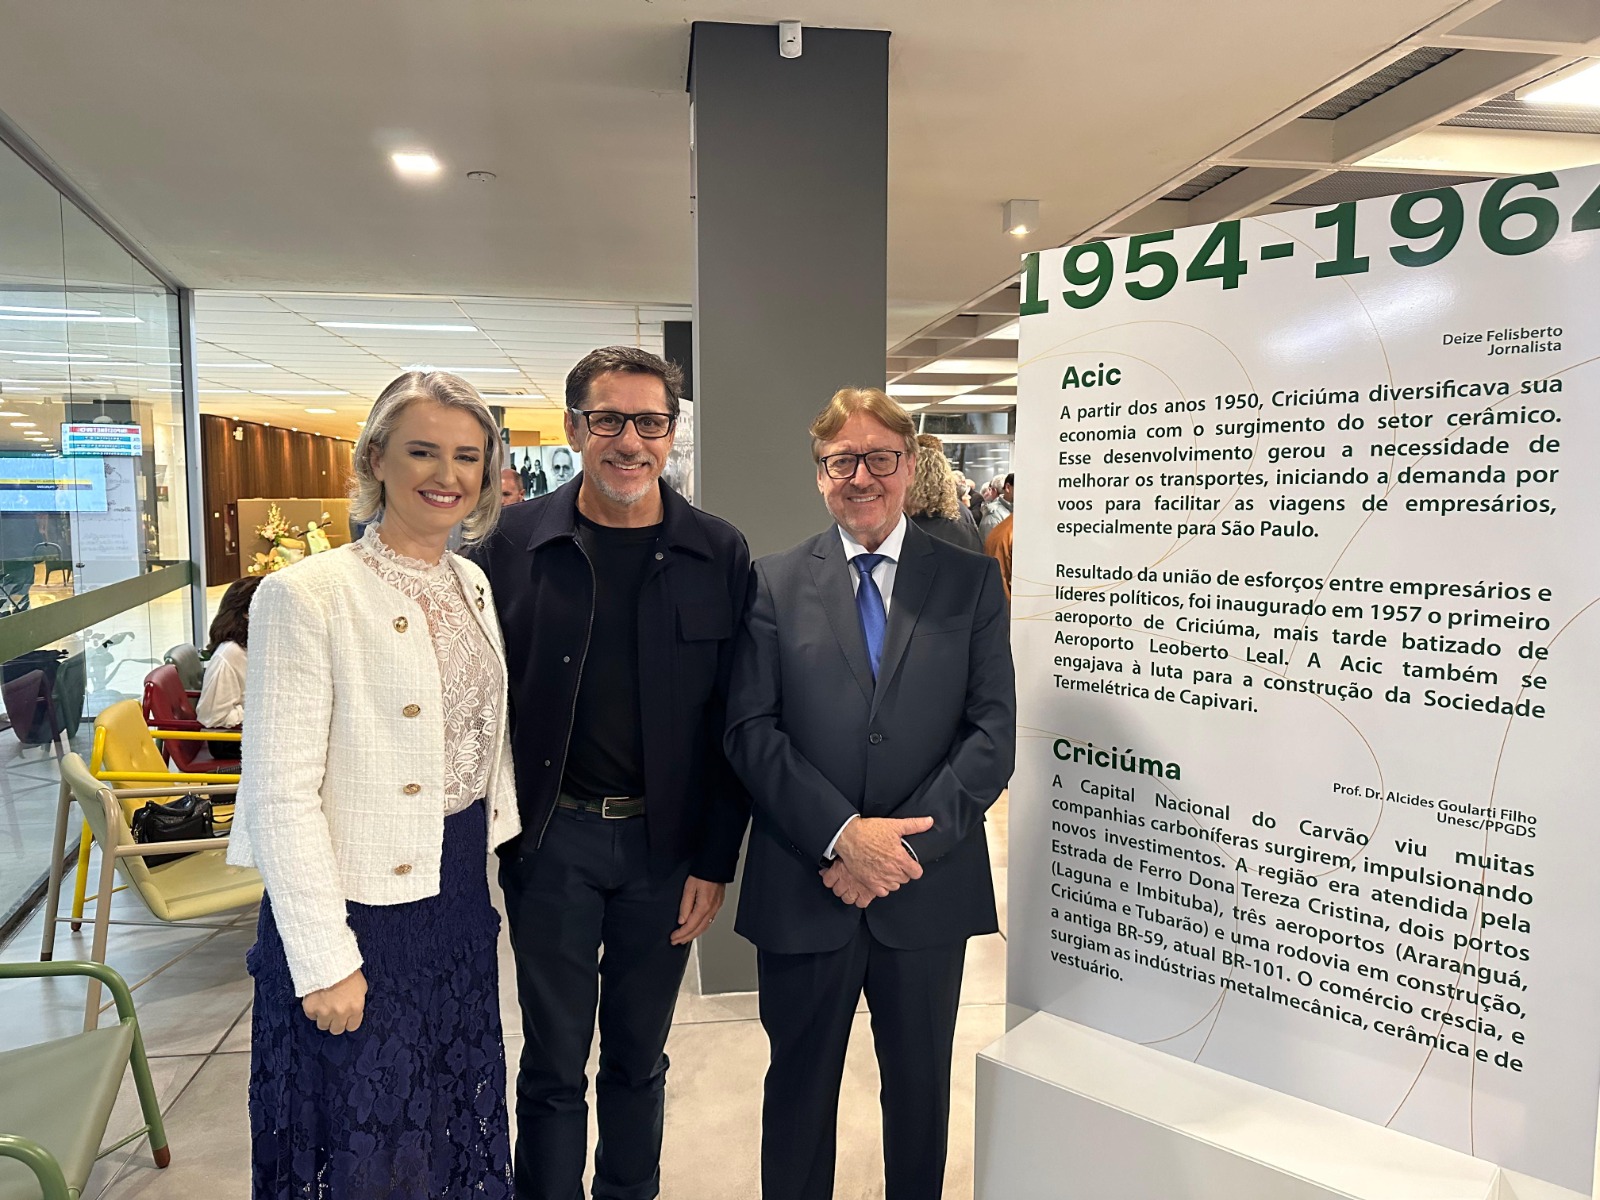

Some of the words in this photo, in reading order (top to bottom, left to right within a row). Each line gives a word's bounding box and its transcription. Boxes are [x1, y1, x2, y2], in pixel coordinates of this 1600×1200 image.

[1443, 333, 1482, 345] Deize
[1487, 326, 1562, 342] Felisberto
[1488, 340, 1561, 356] Jornalista
[1061, 362, 1122, 390] Acic
[1059, 405, 1071, 420] A
[1077, 401, 1122, 423] partir
[1127, 399, 1158, 416] dos
[1164, 399, 1206, 414] anos
[1214, 392, 1264, 411] 1950,
[1271, 387, 1360, 407] Criciúma
[1368, 379, 1510, 403] diversificava
[1520, 378, 1563, 395] sua
[1059, 424, 1136, 443] economia
[1146, 425, 1183, 439] com
[1193, 424, 1205, 437] o
[1215, 416, 1326, 439] surgimento
[1337, 412, 1365, 431] do
[1377, 412, 1434, 430] setor
[1446, 405, 1562, 427] cerâmico.
[1059, 451, 1092, 466] Esse
[1103, 445, 1253, 464] desenvolvimento
[1267, 445, 1326, 464] gerou
[1341, 444, 1353, 458] a
[1370, 435, 1510, 457] necessidade
[1528, 434, 1561, 454] de
[1058, 472, 1130, 488] melhorar
[1135, 475, 1154, 487] os
[1159, 471, 1269, 490] transportes,
[1276, 466, 1369, 485] iniciando
[1376, 471, 1389, 485] a
[1397, 464, 1506, 484] demanda
[1516, 469, 1560, 488] por
[1057, 499, 1093, 511] voos
[1105, 499, 1141, 515] para
[1154, 494, 1221, 511] facilitar
[1234, 498, 1254, 511] as
[1268, 494, 1346, 516] viagens
[1361, 493, 1389, 512] de
[1405, 493, 1557, 517] empresários,
[1056, 518, 1173, 537] especialmente
[1177, 523, 1216, 539] para
[1221, 520, 1255, 537] São
[1260, 520, 1319, 538] Paulo.
[1056, 563, 1133, 581] Resultado
[1137, 566, 1158, 583] da
[1162, 568, 1212, 585] união
[1216, 569, 1240, 586] de
[1244, 570, 1324, 594] esforços
[1328, 577, 1384, 594] entre
[1389, 580, 1531, 601] empresários
[1537, 588, 1552, 602] e
[1055, 585, 1106, 603] líderes
[1109, 589, 1184, 610] políticos,
[1188, 592, 1211, 610] foi
[1216, 594, 1327, 617] inaugurado
[1331, 605, 1363, 619] em
[1370, 604, 1422, 623] 1957
[1427, 611, 1442, 624] o
[1447, 608, 1550, 631] primeiro
[1054, 611, 1133, 629] aeroporto
[1143, 613, 1165, 630] de
[1175, 616, 1261, 640] Criciúma,
[1273, 625, 1319, 642] mais
[1331, 628, 1387, 648] tarde
[1401, 631, 1502, 657] batizado
[1518, 640, 1549, 663] de
[1054, 630, 1134, 651] Aeroporto
[1149, 638, 1229, 660] Leoberto
[1246, 646, 1290, 666] Leal.
[1306, 652, 1322, 669] A
[1339, 654, 1383, 675] Acic
[1402, 661, 1498, 685] também
[1521, 673, 1548, 690] se
[1052, 673, 1150, 700] Termelétrica
[1154, 685, 1176, 703] de
[1179, 689, 1258, 713] Capivari.
[1053, 655, 1123, 674] engajava
[1131, 659, 1141, 675] à
[1150, 661, 1183, 680] luta
[1193, 670, 1233, 685] para
[1242, 675, 1253, 688] a
[1263, 677, 1373, 702] construção
[1384, 685, 1411, 704] da
[1423, 689, 1546, 719] Sociedade
[1053, 738, 1181, 780] Criciúma
[1051, 773, 1063, 789] A
[1080, 779, 1135, 803] Capital
[1155, 791, 1230, 821] Nacional
[1251, 811, 1277, 829] do
[1299, 819, 1372, 848] Carvão
[1394, 838, 1427, 858] viu
[1455, 851, 1534, 877] muitas
[1333, 783, 1361, 797] Prof.
[1365, 788, 1383, 800] Dr.
[1385, 791, 1435, 809] Alcides
[1438, 800, 1496, 818] Goularti
[1500, 808, 1537, 825] Filho
[1436, 812, 1536, 838] Unesc/PPGDS
[1051, 798, 1146, 828] companhias
[1150, 819, 1259, 851] carboníferas
[1264, 841, 1357, 873] surgirem,
[1363, 856, 1533, 906] impulsionando
[1051, 820, 1097, 840] novos
[1104, 827, 1226, 869] investimentos.
[1235, 858, 1248, 873] A
[1258, 864, 1318, 888] região
[1328, 880, 1360, 897] era
[1371, 889, 1468, 920] atendida
[1480, 911, 1531, 934] pela
[1051, 838, 1107, 865] Estrada
[1112, 853, 1134, 871] de
[1139, 858, 1183, 882] Ferro
[1189, 870, 1235, 895] Dona
[1240, 881, 1300, 910] Tereza
[1308, 897, 1390, 932] Cristina,
[1398, 917, 1445, 942] dois
[1453, 933, 1530, 962] portos
[1051, 860, 1112, 889] (Laguna
[1119, 881, 1130, 893] e
[1137, 881, 1224, 918] Imbituba),
[1232, 905, 1267, 926] três
[1275, 918, 1385, 955] aeroportos
[1395, 942, 1528, 992] (Araranguá,
[1050, 950, 1124, 982] vestuário.
[1051, 882, 1117, 913] Criciúma
[1121, 904, 1132, 916] e
[1134, 903, 1209, 938] Tubarão)
[1214, 928, 1225, 941] e
[1230, 931, 1270, 952] uma
[1276, 943, 1350, 973] rodovia
[1357, 964, 1389, 983] em
[1396, 974, 1526, 1020] construção,
[1050, 907, 1059, 919] a
[1063, 910, 1112, 934] antiga
[1117, 921, 1168, 951] BR-59,
[1173, 940, 1216, 962] atual
[1222, 947, 1291, 983] BR-101.
[1297, 970, 1313, 987] O
[1319, 980, 1414, 1015] comércio
[1420, 1007, 1503, 1042] crescia,
[1511, 1031, 1525, 1045] e
[1050, 928, 1111, 956] surgiam
[1113, 947, 1131, 961] as
[1134, 948, 1216, 985] indústrias
[1220, 976, 1369, 1031] metalmecânica,
[1373, 1020, 1469, 1058] cerâmica
[1475, 1048, 1489, 1063] e
[1493, 1050, 1524, 1073] de
